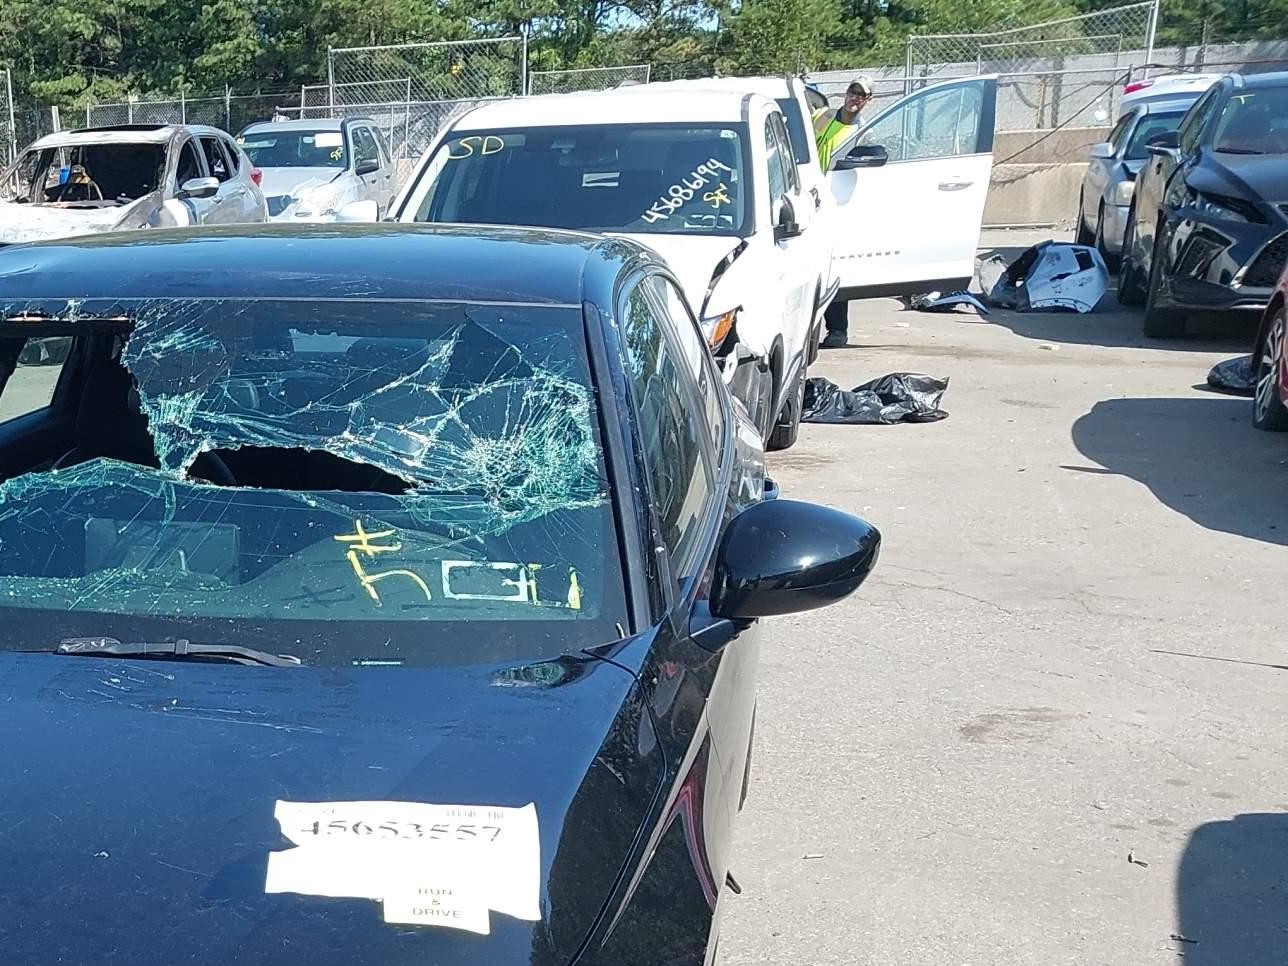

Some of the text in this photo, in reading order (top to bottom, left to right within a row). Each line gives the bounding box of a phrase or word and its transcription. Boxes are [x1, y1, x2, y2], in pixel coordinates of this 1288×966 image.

[447, 135, 505, 159] SD
[640, 158, 732, 223] 45686194
[412, 906, 462, 919] DRIVE
